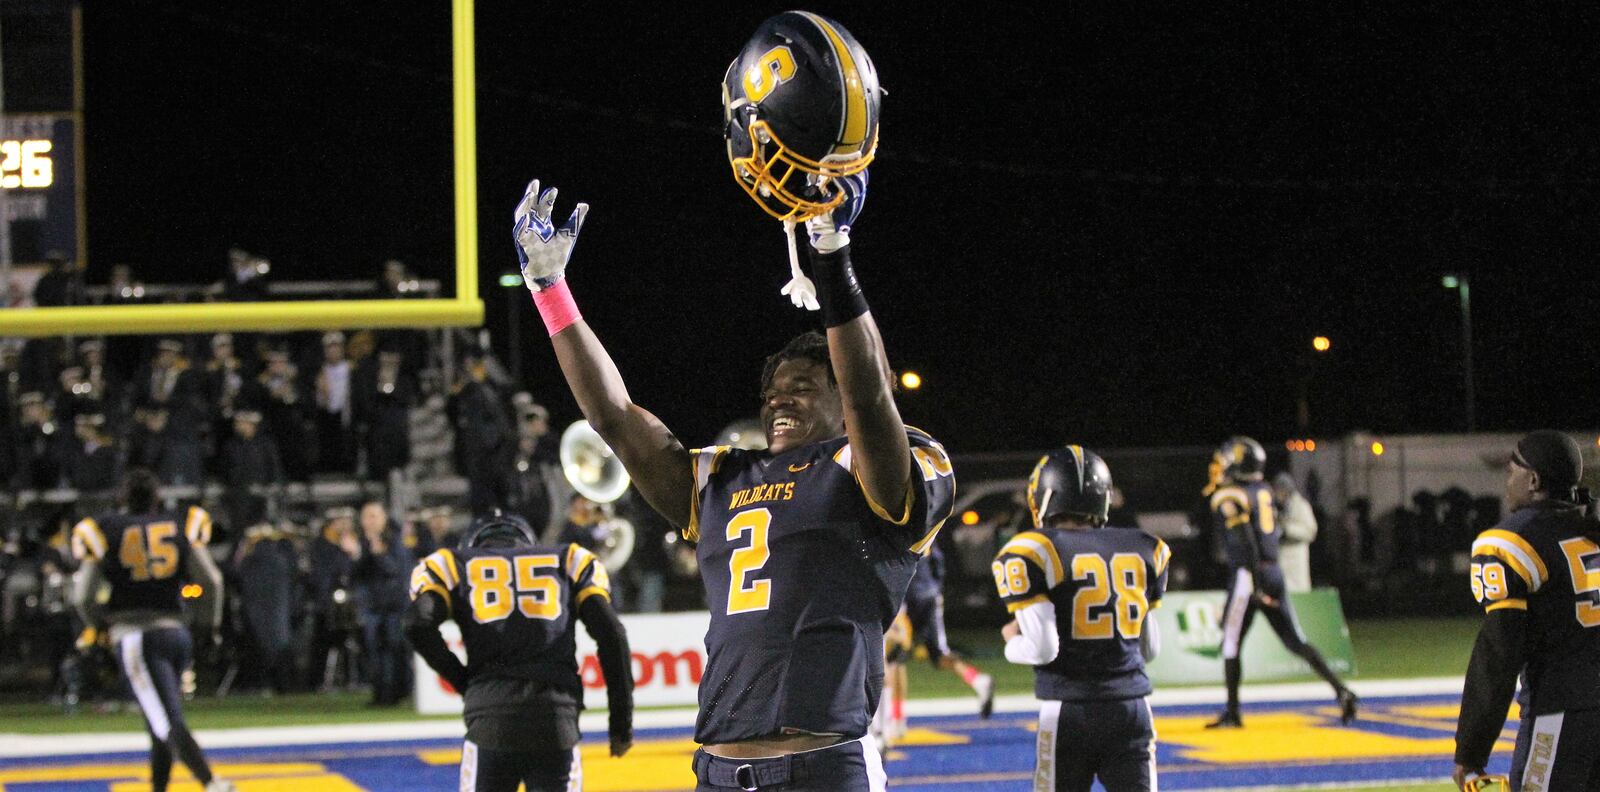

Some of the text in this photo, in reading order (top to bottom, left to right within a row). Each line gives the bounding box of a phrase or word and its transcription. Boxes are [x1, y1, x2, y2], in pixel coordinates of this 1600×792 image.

[743, 45, 798, 104] S
[0, 140, 53, 188] 26
[729, 481, 796, 510] WILDCATS
[120, 520, 179, 581] 45
[725, 507, 772, 616] 2
[991, 557, 1031, 599] 28
[465, 554, 563, 625] 85
[1071, 552, 1150, 640] 28
[1470, 562, 1509, 603] 59
